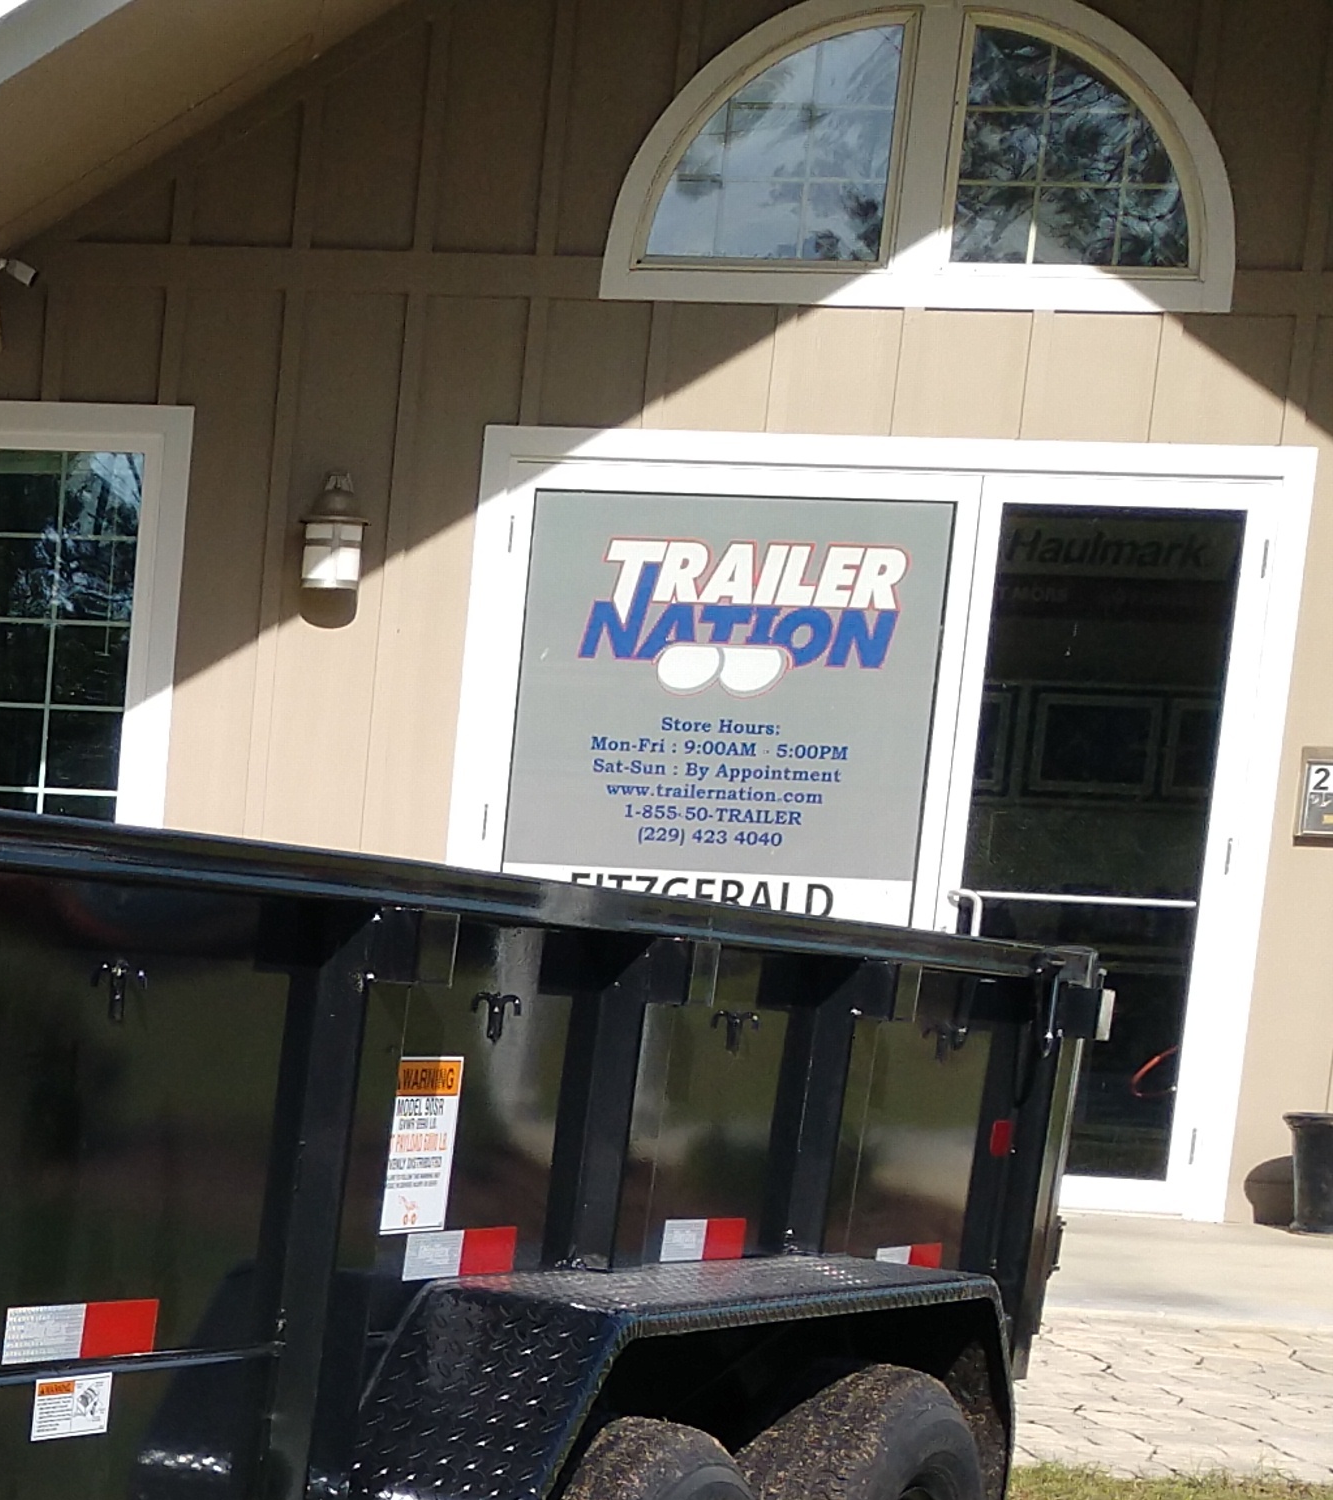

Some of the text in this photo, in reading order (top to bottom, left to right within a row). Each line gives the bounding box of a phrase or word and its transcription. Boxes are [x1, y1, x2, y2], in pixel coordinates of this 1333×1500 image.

[1001, 528, 1206, 568] Haulmark
[604, 537, 910, 614] TRAILER
[578, 590, 900, 669] NATION
[661, 717, 781, 736] Store Hours:
[591, 736, 665, 753] Mon-Fri
[684, 740, 756, 757] 9:00AM
[776, 744, 849, 761] 5:00PM
[593, 759, 666, 776] Sat-Sun
[685, 762, 709, 781] By
[715, 764, 842, 784] Appointment
[606, 784, 823, 805] www.trailernation.com
[624, 804, 802, 825] 1-855-50-TRAILER
[638, 827, 783, 847] (229) 423 4040
[403, 1067, 455, 1090] WARNING
